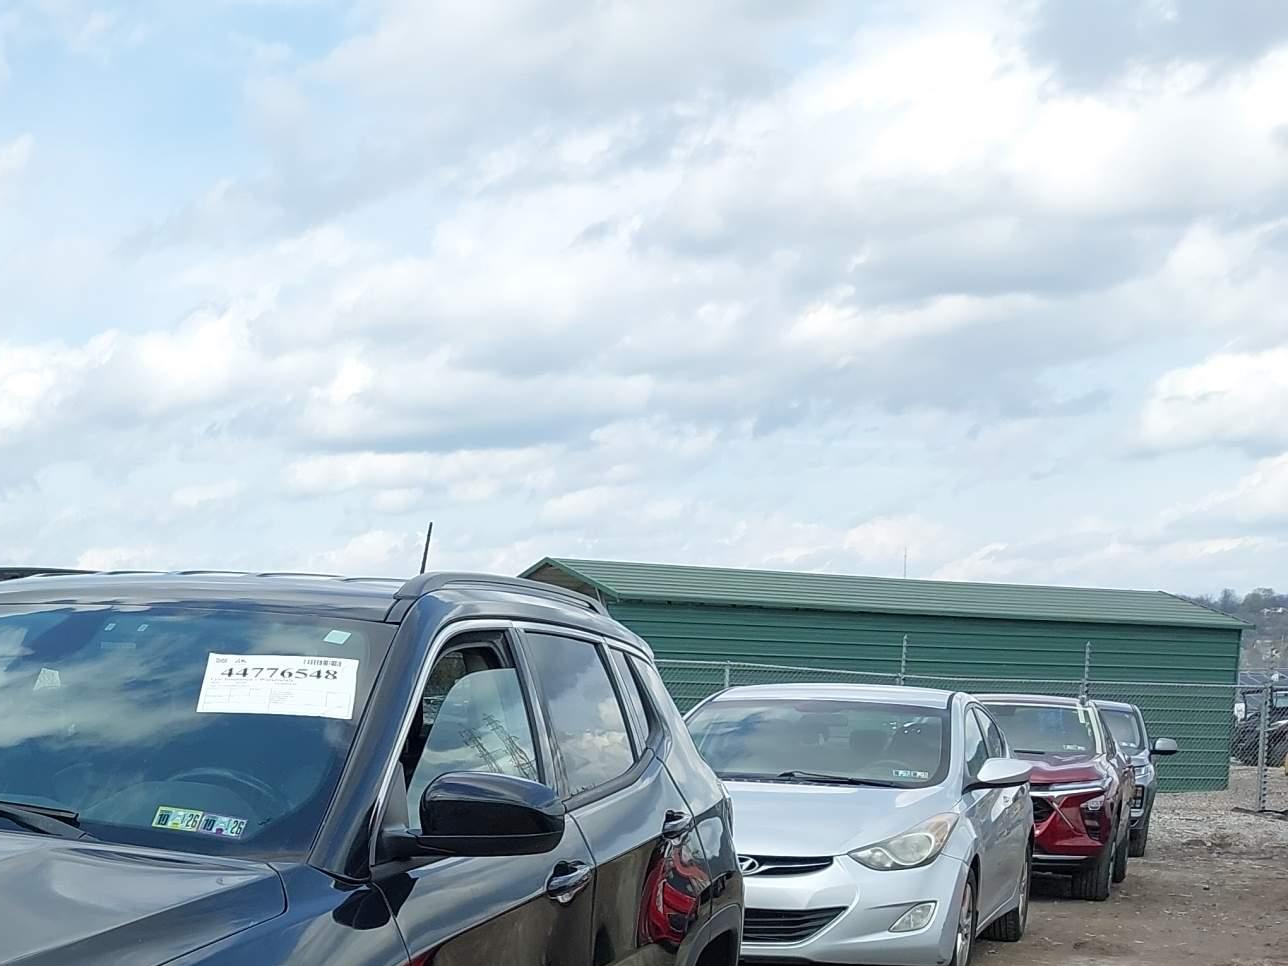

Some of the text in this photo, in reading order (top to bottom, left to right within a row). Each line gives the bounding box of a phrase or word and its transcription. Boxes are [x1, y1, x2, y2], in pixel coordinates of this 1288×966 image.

[220, 667, 338, 680] 44776548
[185, 813, 200, 829] 26
[230, 820, 245, 835] 26
